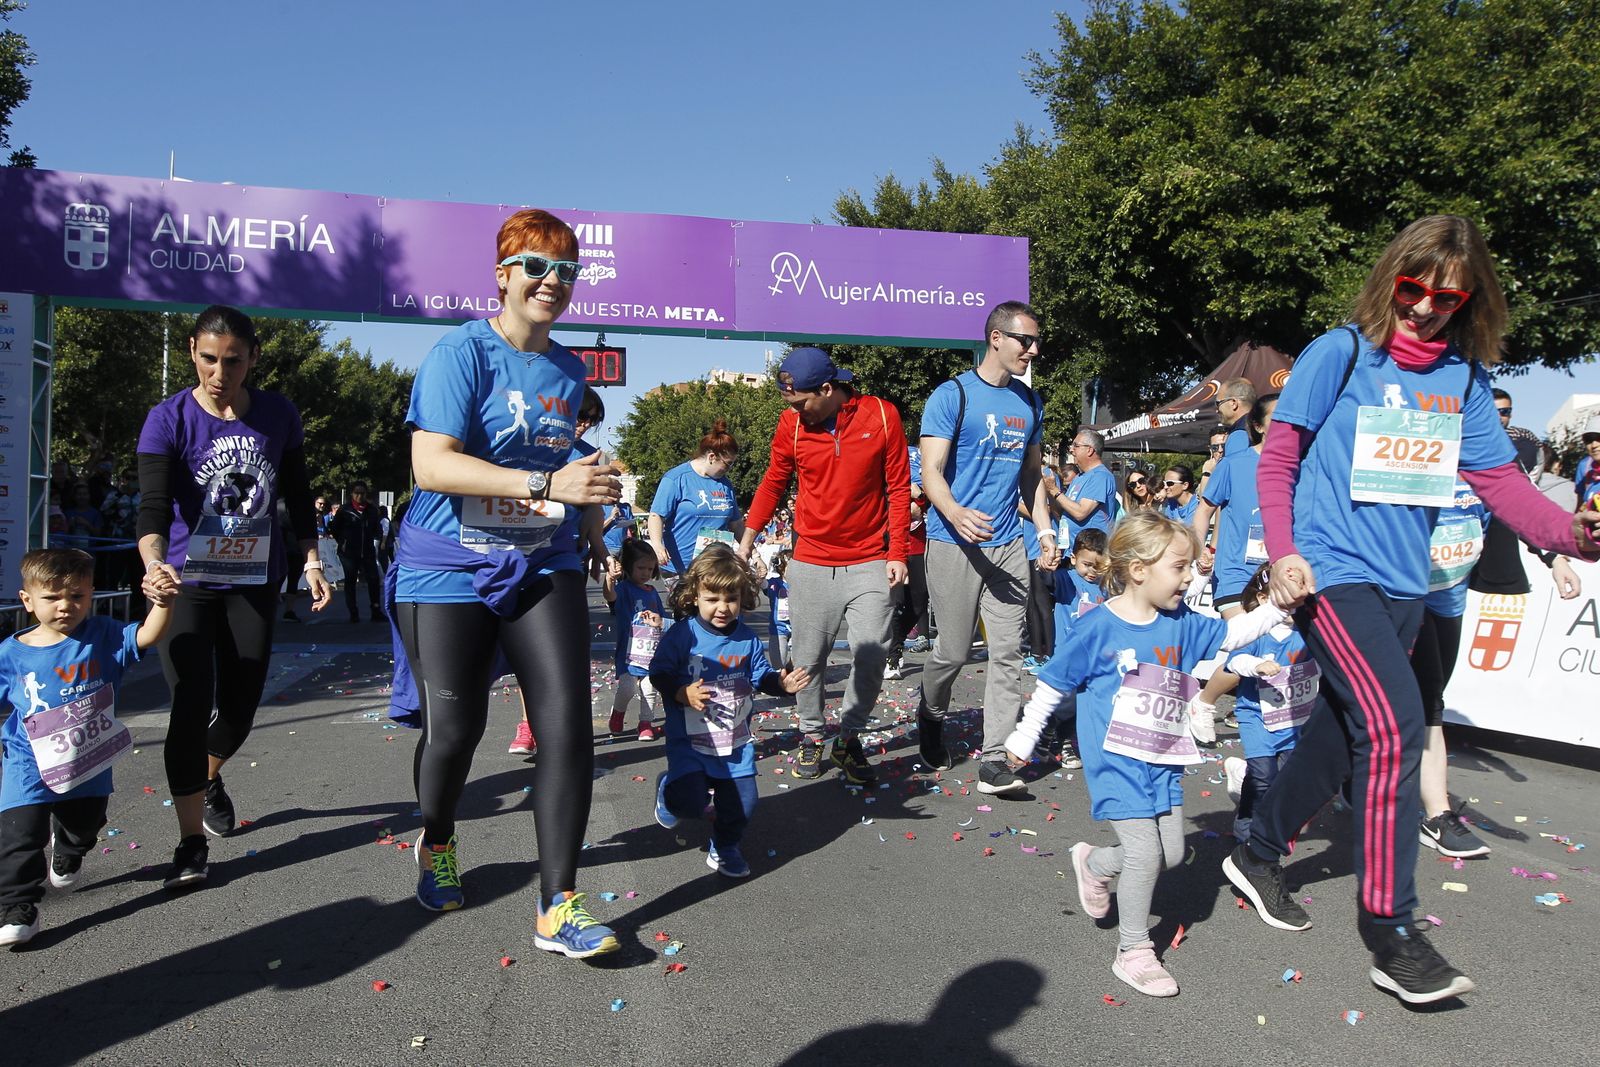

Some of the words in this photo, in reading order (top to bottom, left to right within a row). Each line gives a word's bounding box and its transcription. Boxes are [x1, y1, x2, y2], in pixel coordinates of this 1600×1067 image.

[151, 212, 335, 254] ALMERÍA
[150, 248, 245, 273] CIUDAD
[579, 248, 616, 258] RRERA
[577, 262, 617, 286] ujer
[393, 294, 416, 309] LA
[424, 295, 505, 312] IGUALD
[568, 301, 658, 319] NUESTRA
[664, 306, 725, 323] META.
[1415, 391, 1460, 413] VIII
[212, 436, 256, 454] JUNTAS
[1374, 436, 1444, 463] 2022
[206, 536, 259, 555] 1257
[1430, 541, 1474, 562] 2042
[1272, 680, 1312, 703] 3039
[1134, 692, 1184, 724] 3023
[50, 712, 113, 754] 3088
